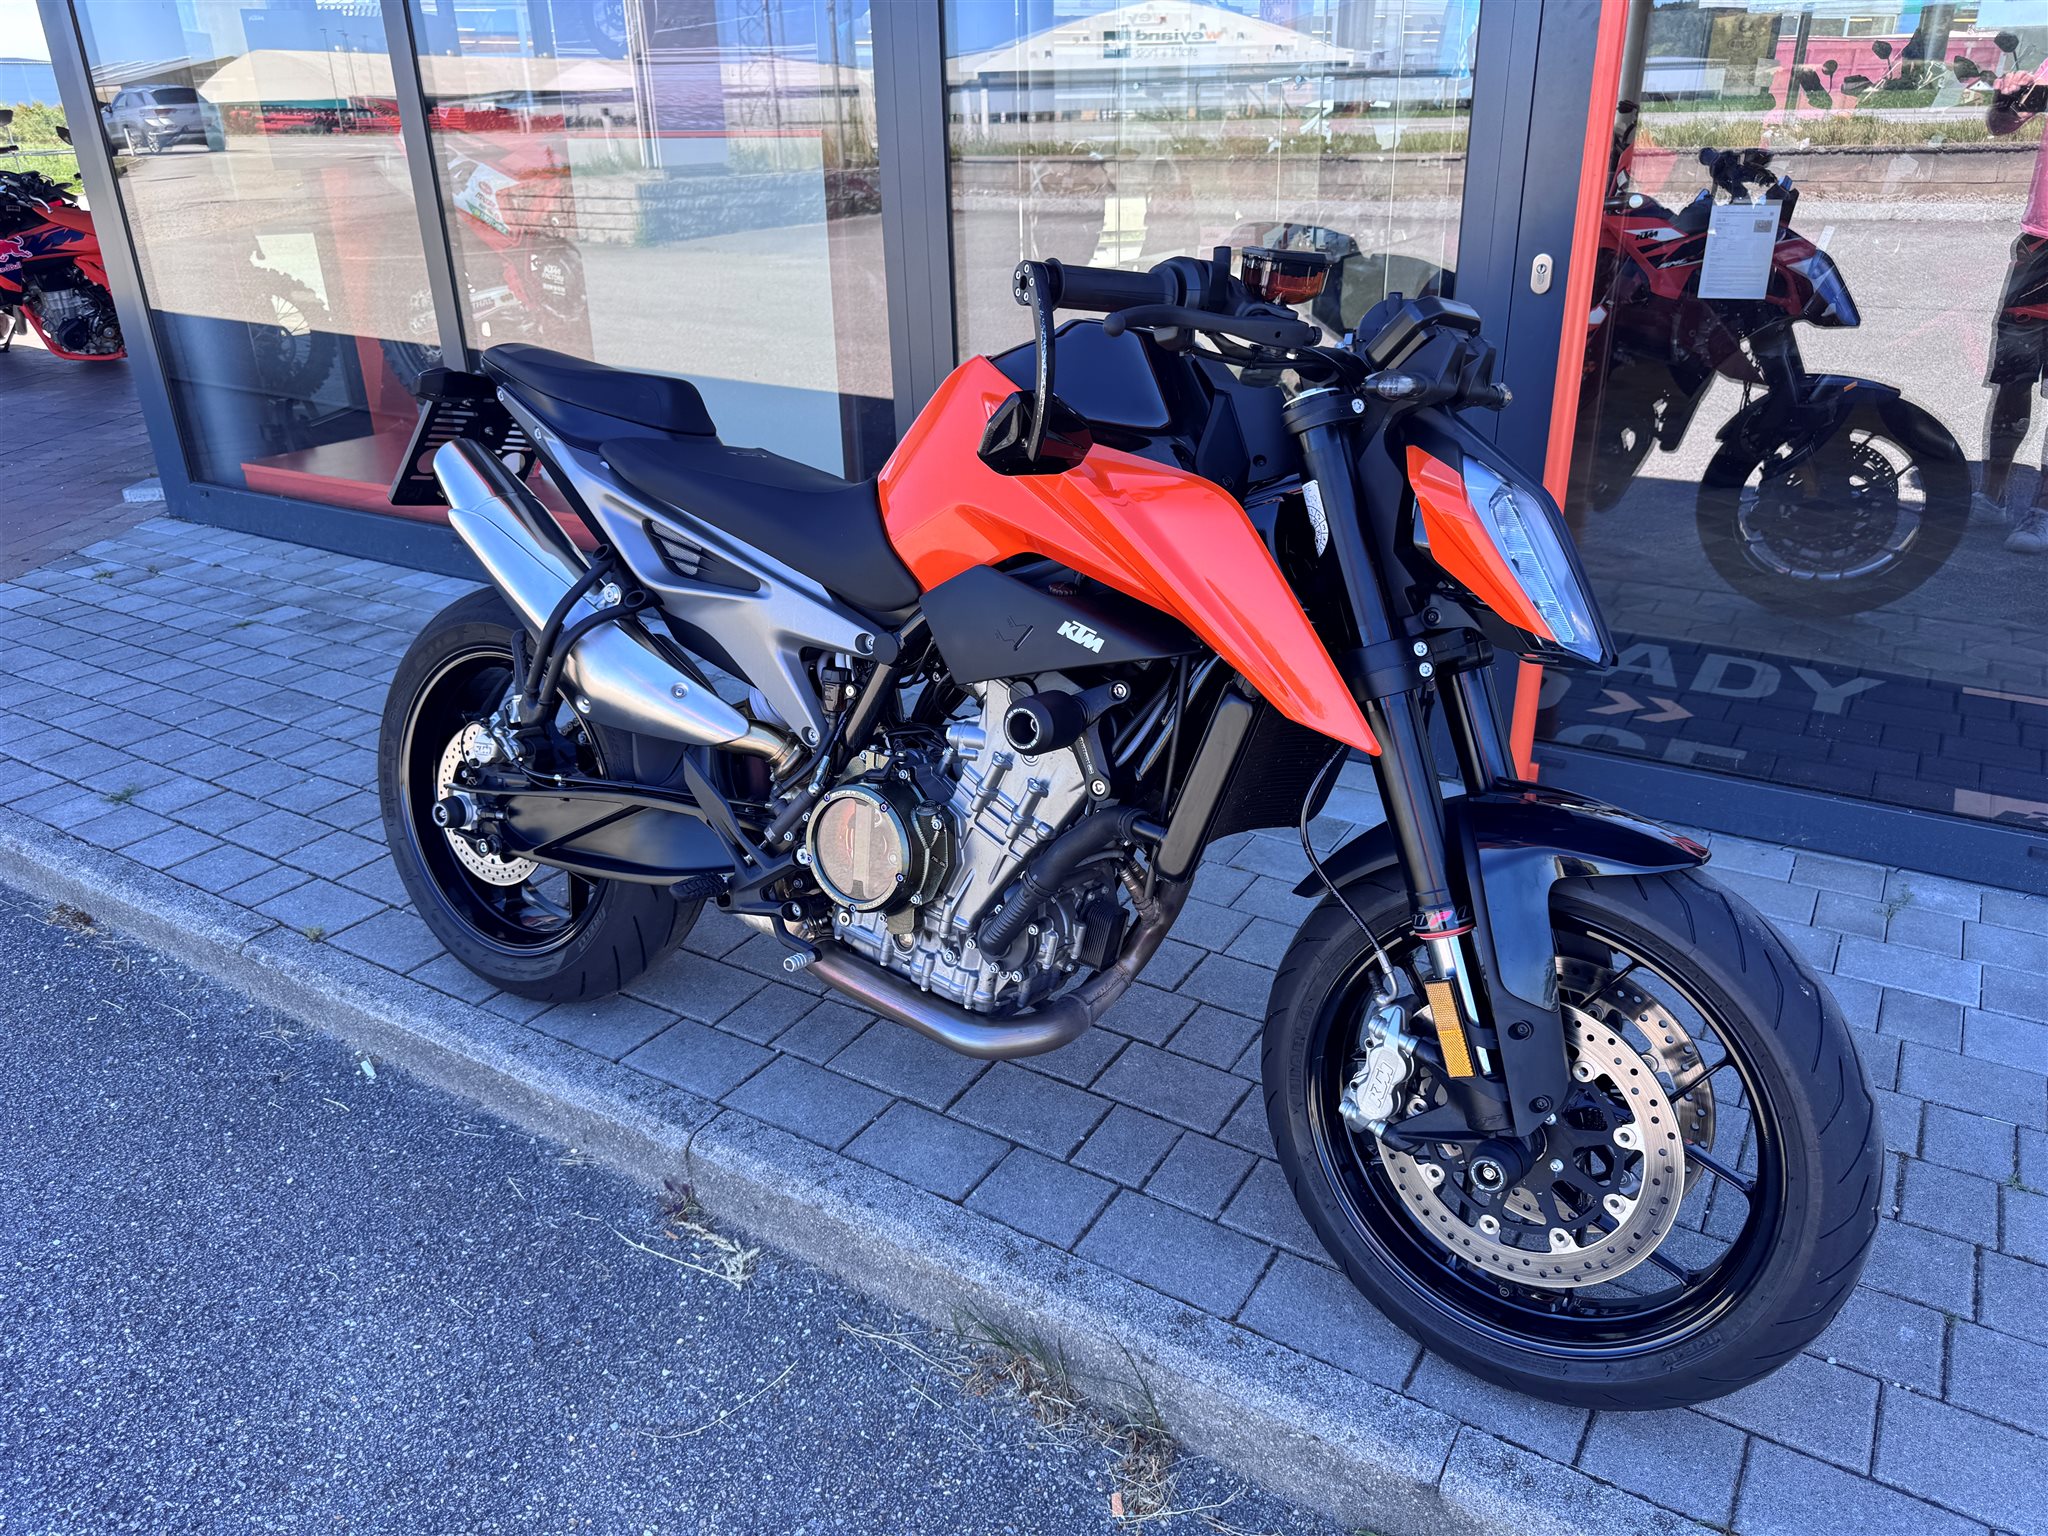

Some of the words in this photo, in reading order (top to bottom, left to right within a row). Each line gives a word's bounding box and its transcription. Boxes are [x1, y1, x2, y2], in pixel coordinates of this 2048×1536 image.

[1635, 229, 1658, 240] KTM
[1057, 620, 1105, 654] KTM
[1585, 643, 1886, 715] ADY
